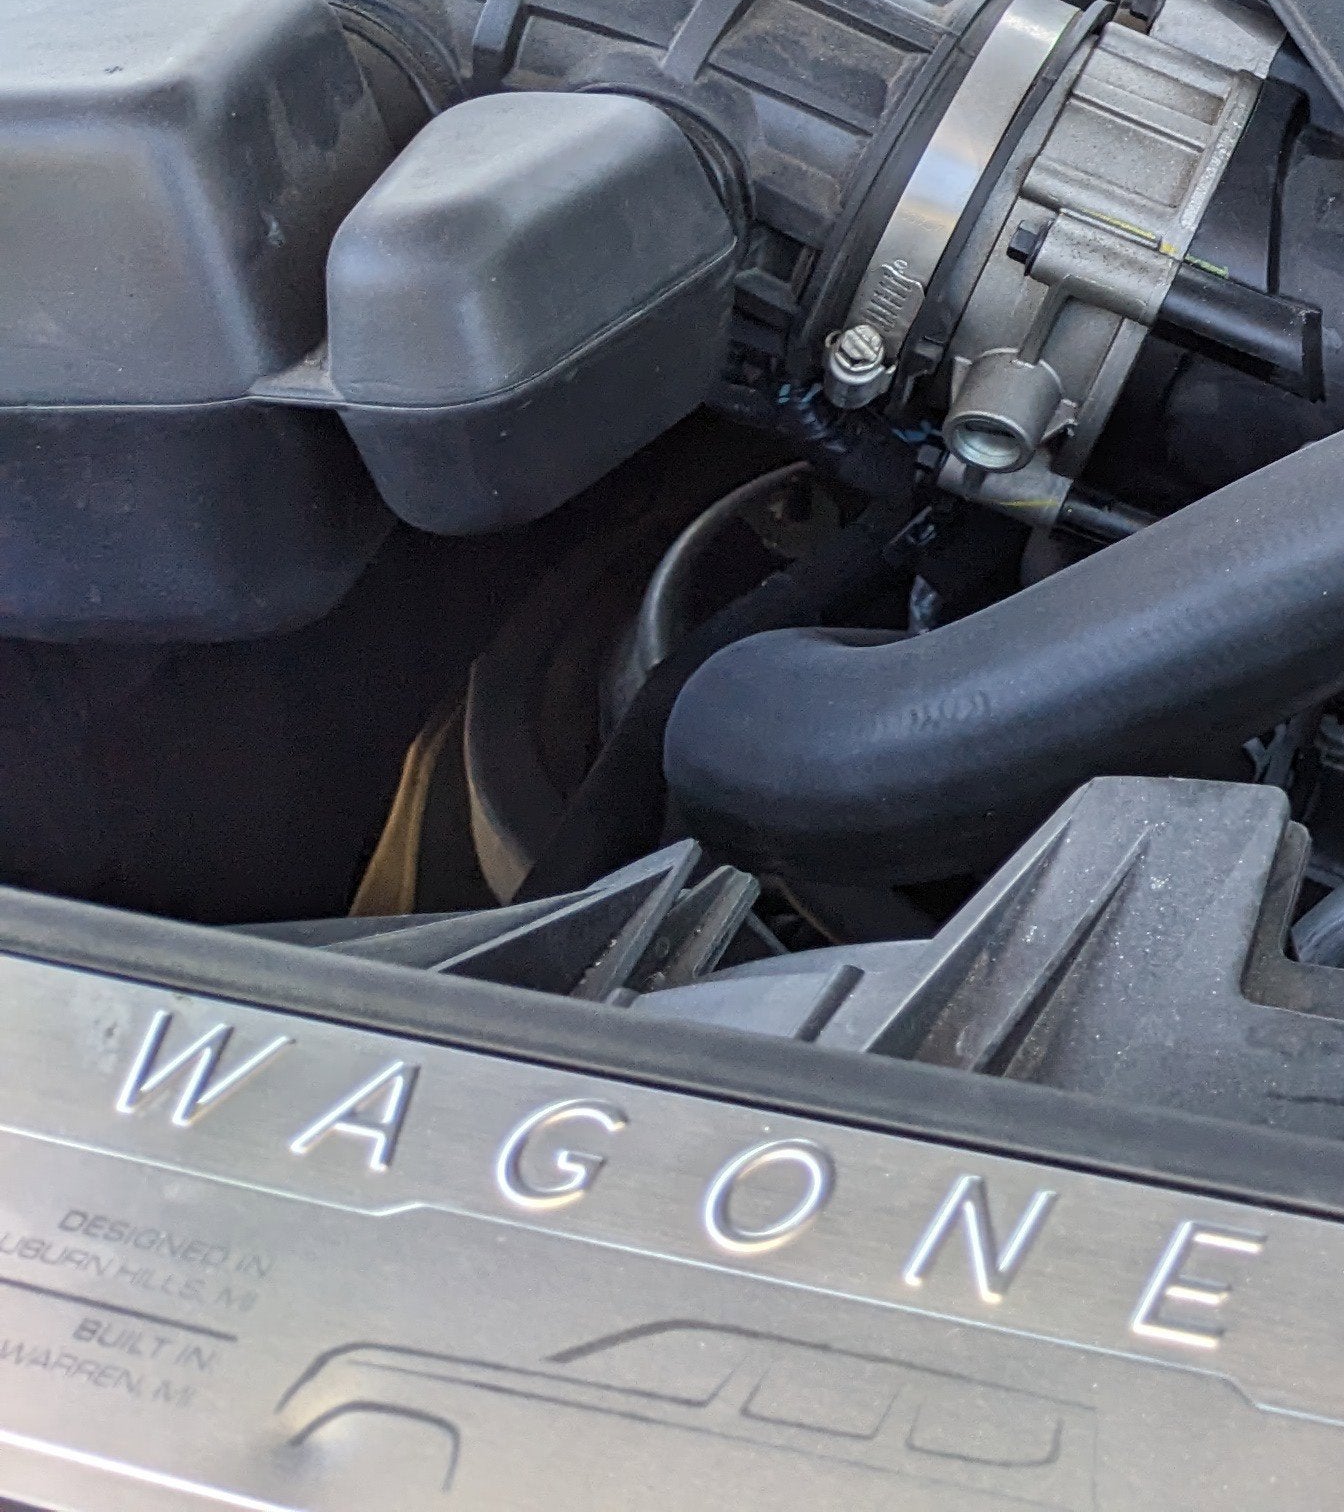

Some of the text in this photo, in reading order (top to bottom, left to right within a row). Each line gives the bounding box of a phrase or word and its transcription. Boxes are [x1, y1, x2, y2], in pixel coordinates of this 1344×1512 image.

[0, 1234, 108, 1276] UBURN
[215, 1287, 257, 1312] MI
[57, 1209, 275, 1279] DESIGNED IN
[72, 1317, 217, 1371] BUILT IN
[151, 1379, 196, 1408] MI
